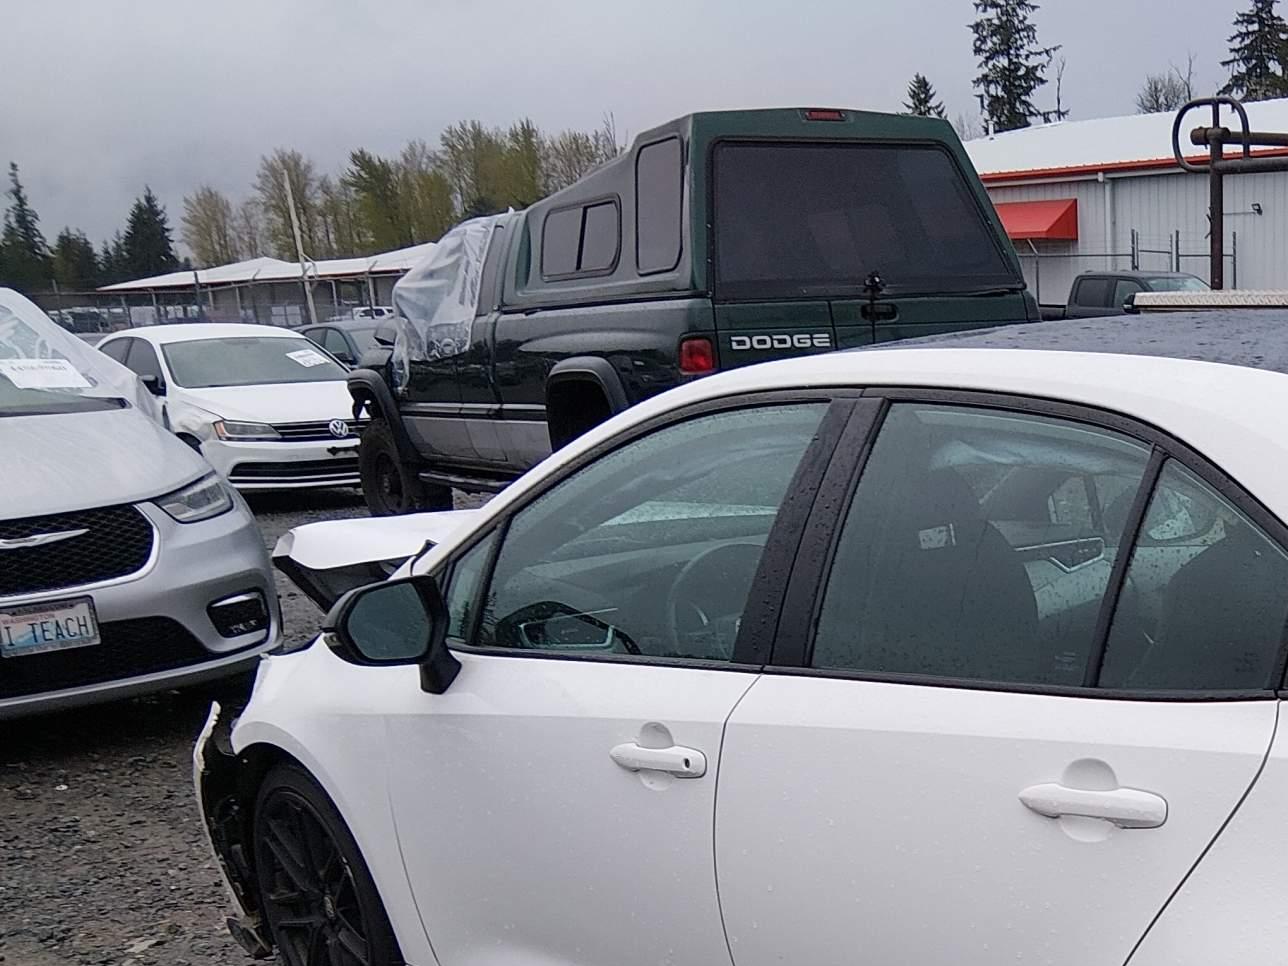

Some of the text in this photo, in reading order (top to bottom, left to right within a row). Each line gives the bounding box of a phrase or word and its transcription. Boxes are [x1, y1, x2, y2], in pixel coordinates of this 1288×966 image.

[730, 333, 831, 350] DODGE
[4, 626, 15, 646] I
[28, 615, 90, 643] TEACH
